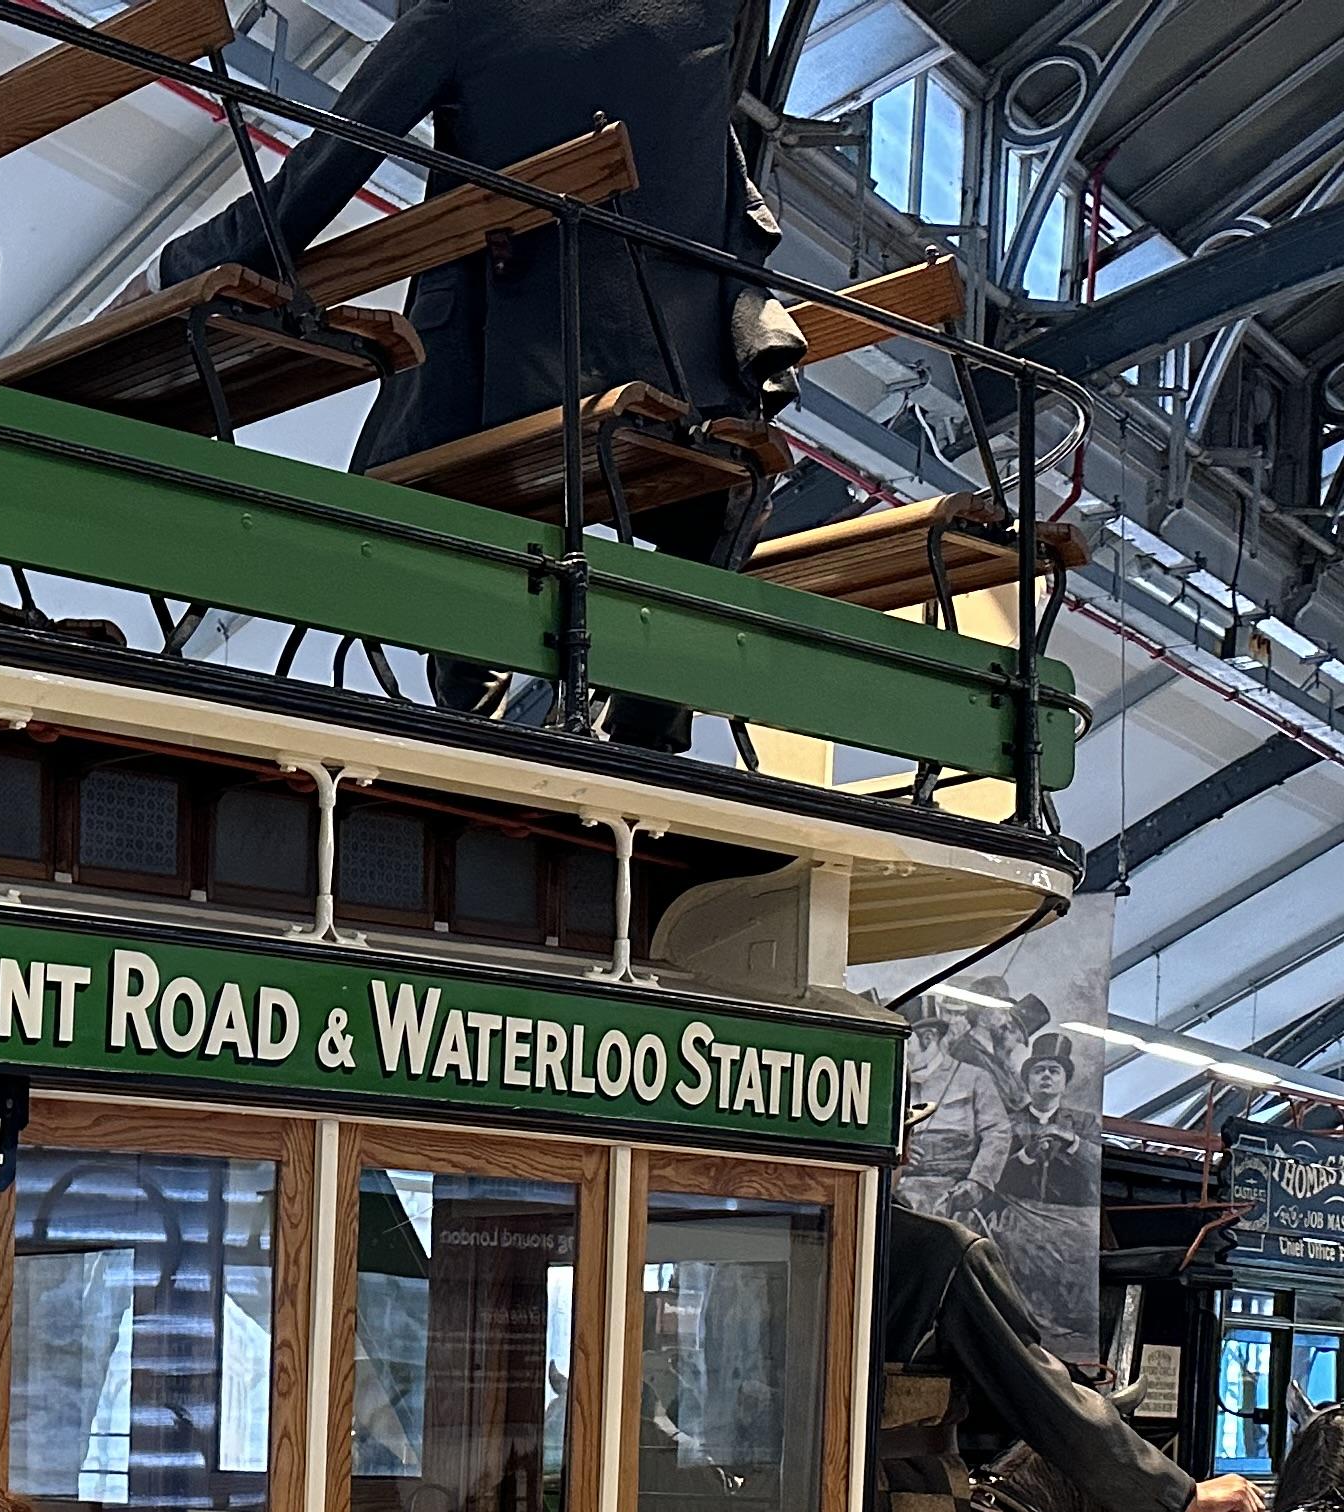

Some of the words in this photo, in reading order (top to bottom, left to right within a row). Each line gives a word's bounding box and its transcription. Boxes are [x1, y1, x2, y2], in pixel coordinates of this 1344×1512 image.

[110, 948, 300, 1061] ROAD
[318, 1005, 357, 1069] &
[371, 980, 668, 1103] WATERLOO
[674, 1020, 872, 1126] STATION
[1304, 1210, 1324, 1230] JOB
